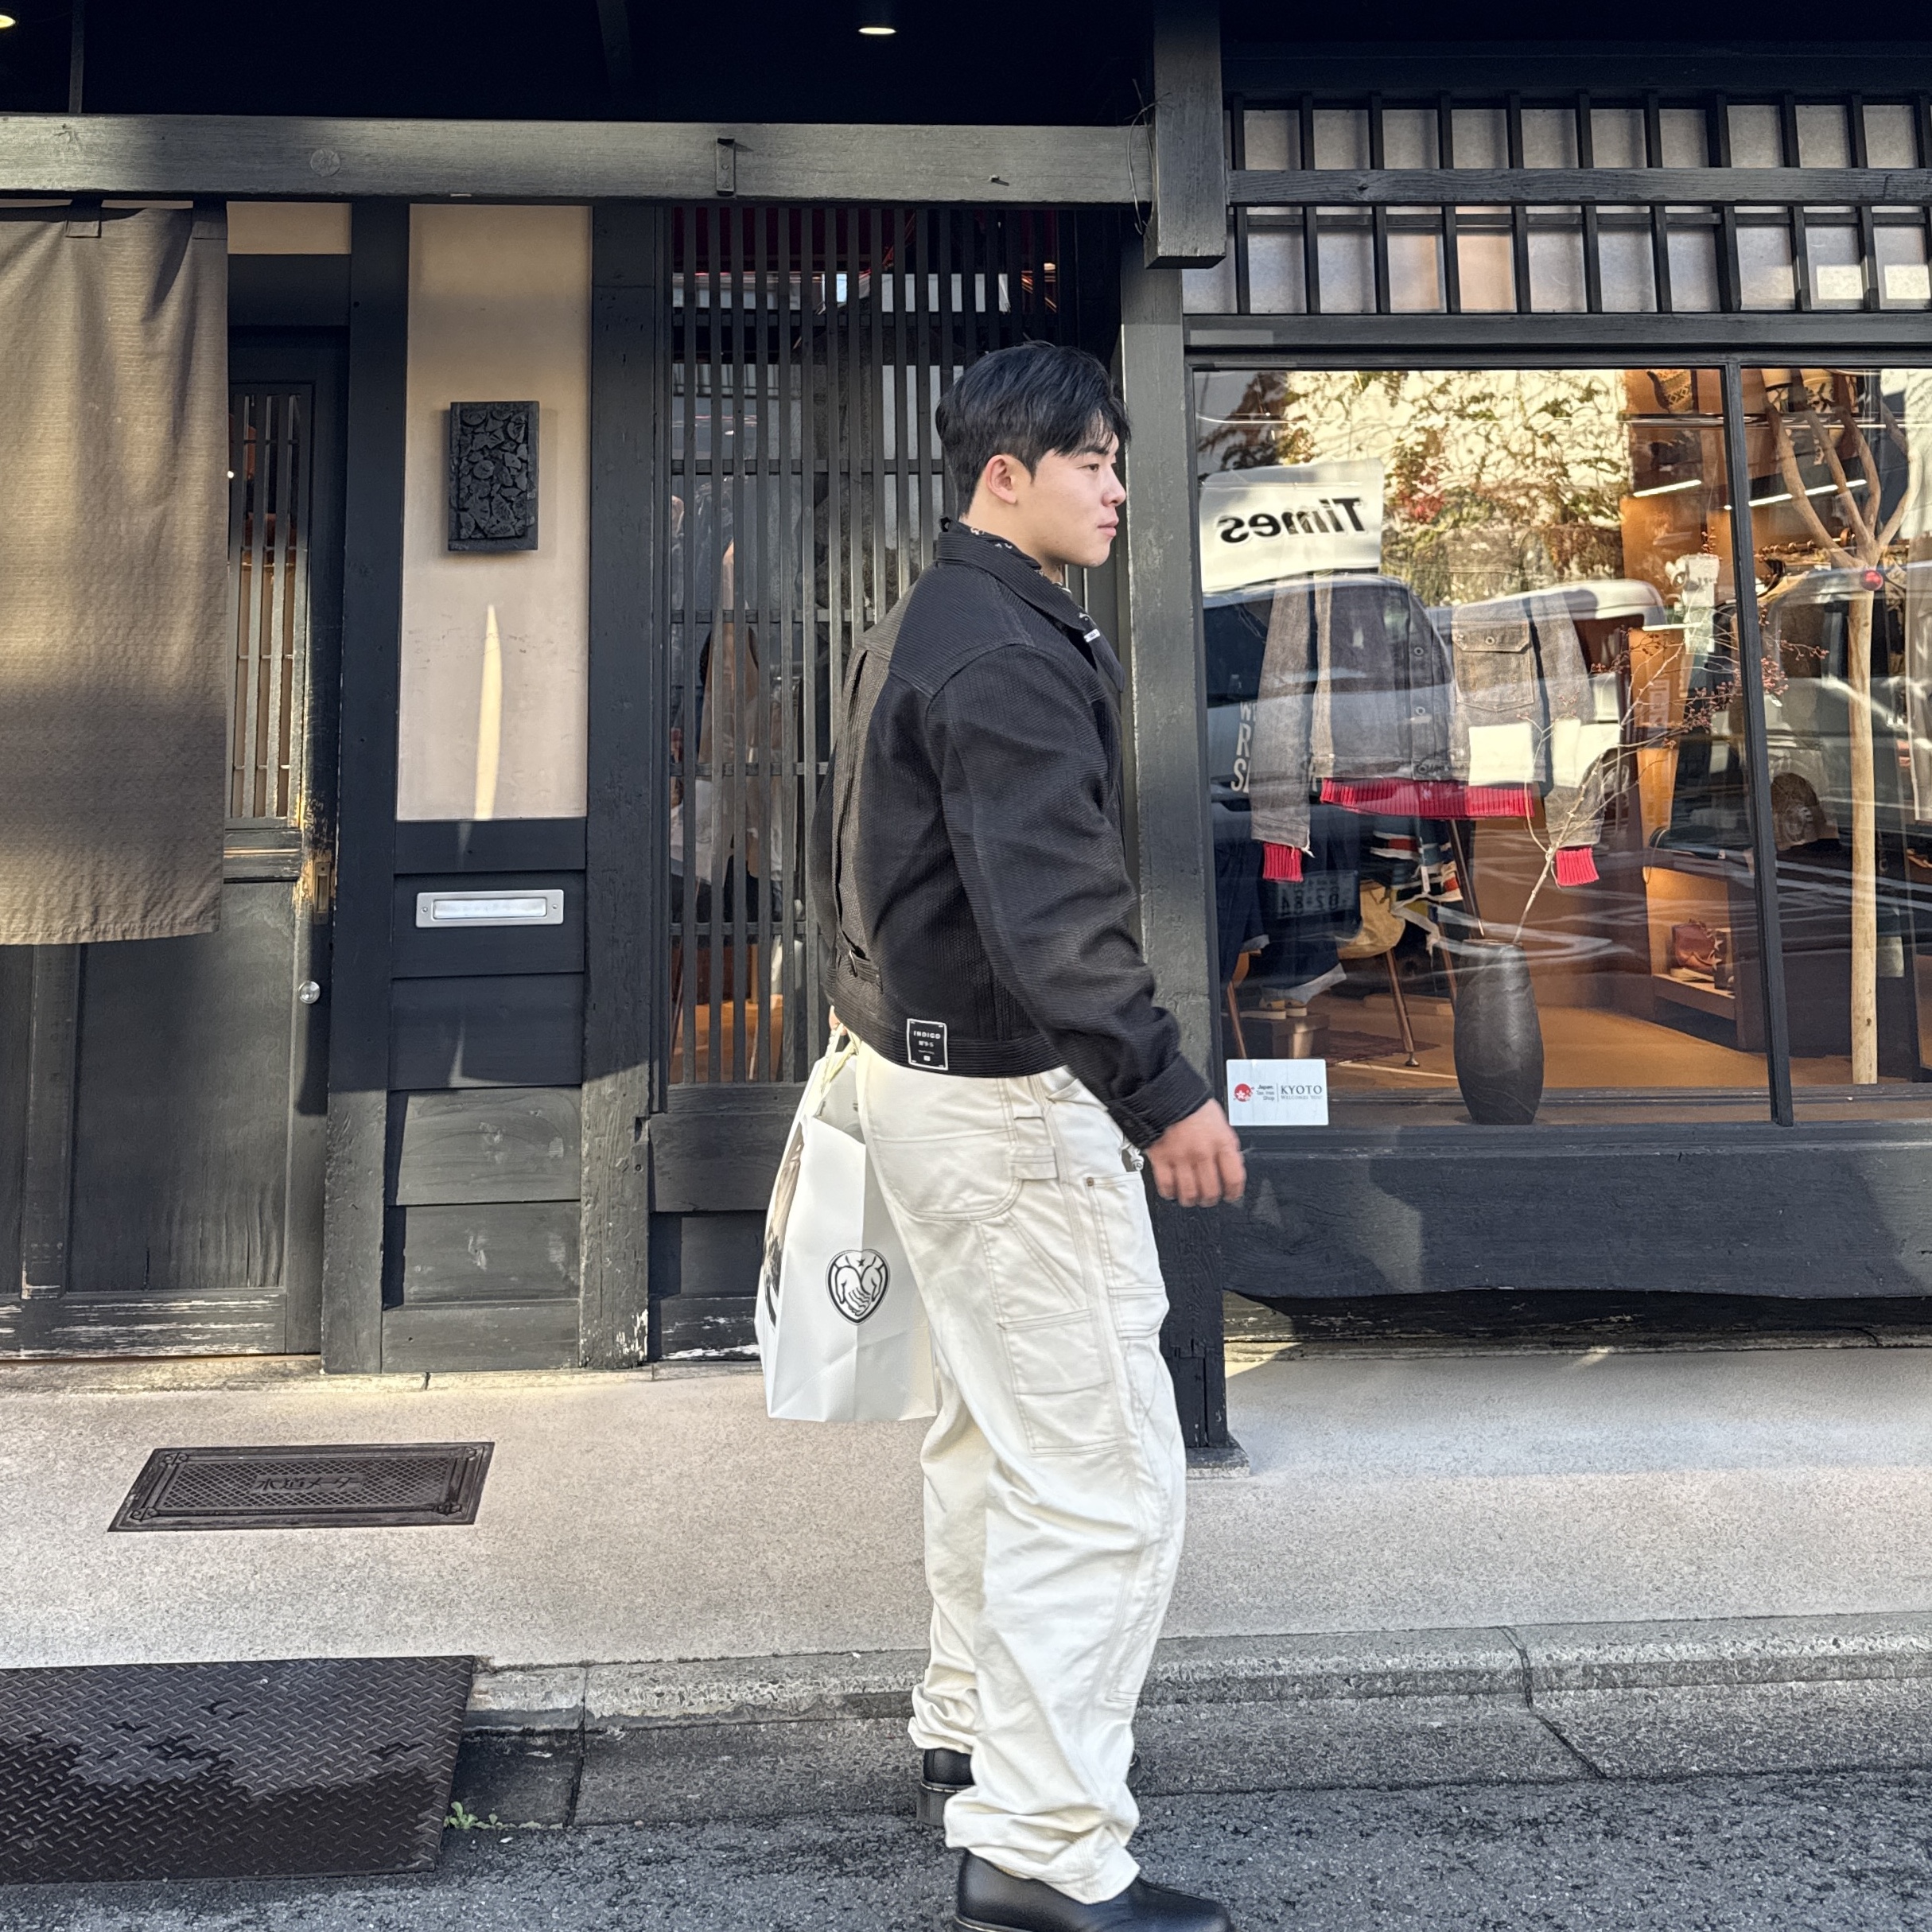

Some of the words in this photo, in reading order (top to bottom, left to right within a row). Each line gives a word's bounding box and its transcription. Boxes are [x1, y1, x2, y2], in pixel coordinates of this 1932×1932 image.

[913, 1030, 941, 1039] INDIGO
[1281, 1085, 1323, 1094] KYOTO
[254, 1476, 363, 1491] 水道メーター
